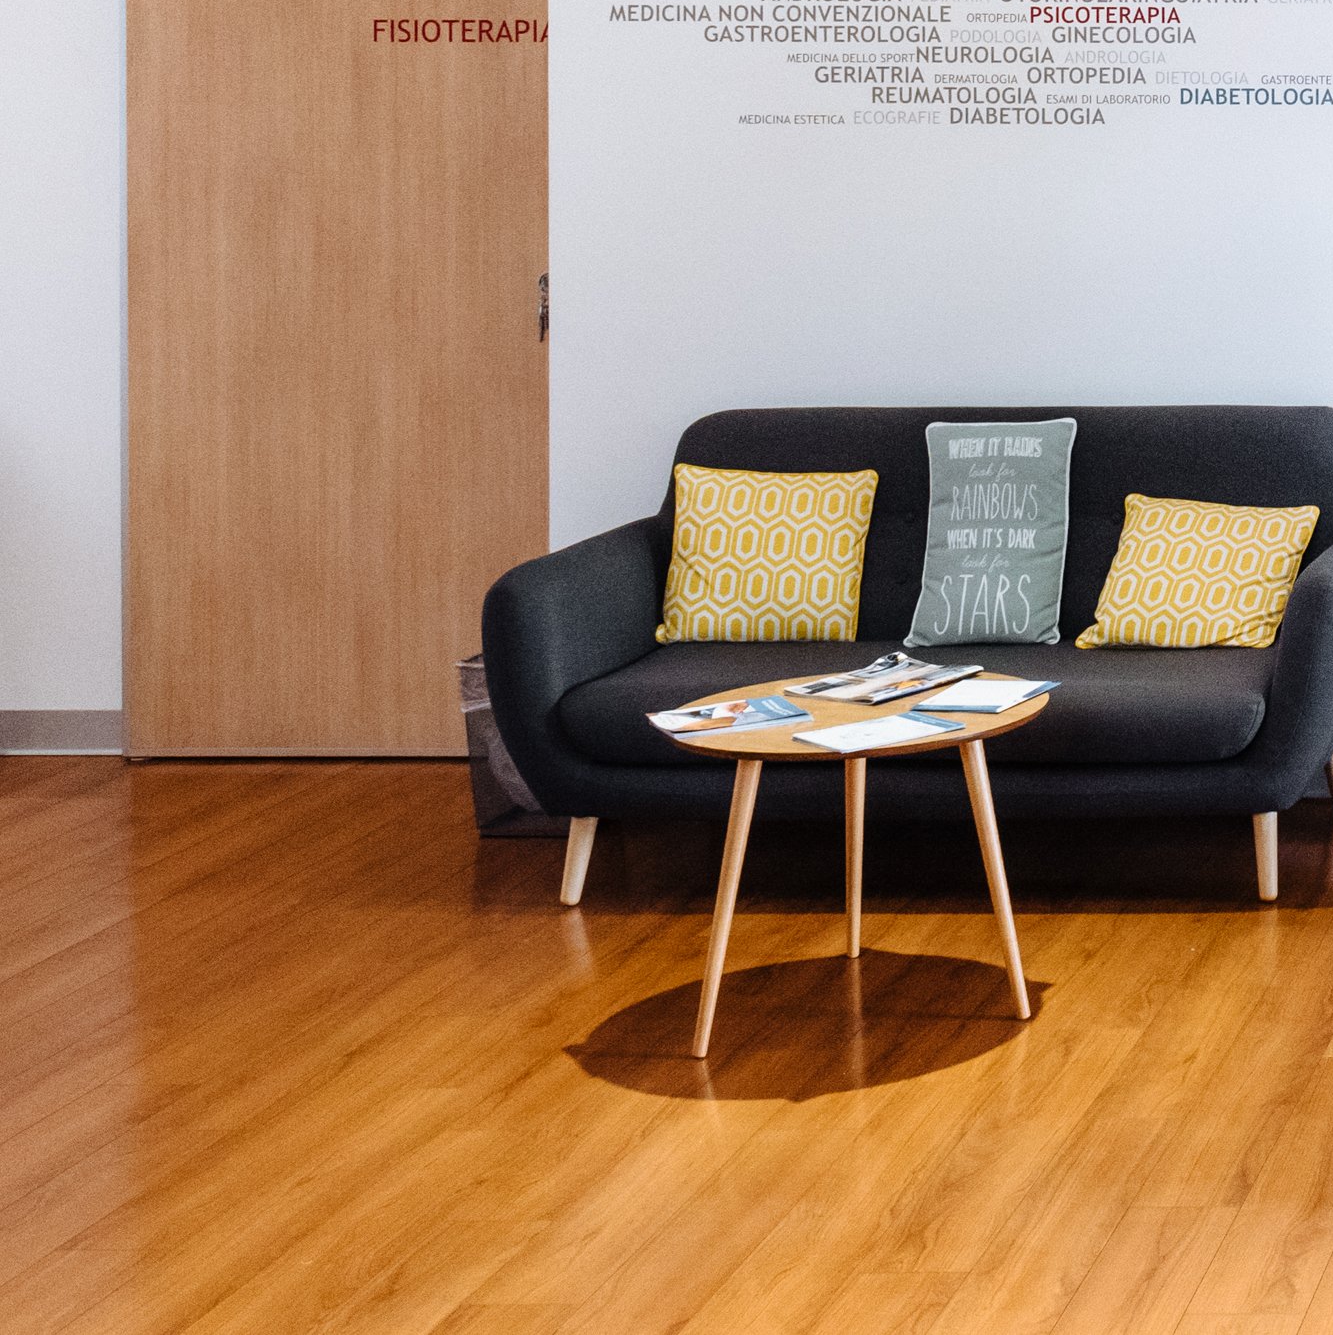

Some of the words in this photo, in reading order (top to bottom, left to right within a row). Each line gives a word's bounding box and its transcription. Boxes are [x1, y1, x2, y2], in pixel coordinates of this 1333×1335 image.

[610, 5, 711, 22] MEDICINA
[720, 6, 764, 22] NON
[773, 6, 951, 23] CONVENZIONALE
[966, 13, 1027, 23] ORTOPEDIA
[1031, 7, 1180, 24] PSICOTERAPIA
[704, 26, 941, 43] GASTROENTEROLOGIA
[950, 29, 1042, 43] PODOLOGIA
[1052, 27, 1196, 44] GINECOLOGIA
[788, 53, 838, 63] MEDICINA
[843, 53, 877, 63] DELLO
[881, 53, 915, 63] SPORT
[917, 47, 1054, 64] NEUROLOGIA
[1065, 51, 1166, 64] ANDROLOGIA
[815, 66, 925, 84] GERIATRIA
[935, 74, 1018, 84] DERMATOLOGIA
[1027, 67, 1145, 85] ORTOPEDIA
[1156, 71, 1248, 85] DIETOLOGIA
[873, 87, 1037, 104] REUMATOLOGIA
[1046, 94, 1077, 105] ESAMI
[1082, 95, 1091, 105] DI
[1096, 94, 1170, 105] LABORATORIO
[1180, 88, 1333, 105] DIABETOLOGIA
[739, 114, 791, 125] MEDICINA
[795, 115, 845, 125] ESTETICA
[854, 111, 940, 125] ECOGRAFIE
[950, 107, 1104, 125] DIABETOLOGIA
[949, 438, 986, 459] WHEN
[988, 437, 1001, 456] IT
[1004, 436, 1042, 458] RAINS
[950, 483, 1038, 521] RAINBOWS
[947, 528, 978, 549] WHEN
[982, 528, 1003, 548] IT'S
[1008, 528, 1036, 549] DARK
[934, 574, 1031, 636] STARS
